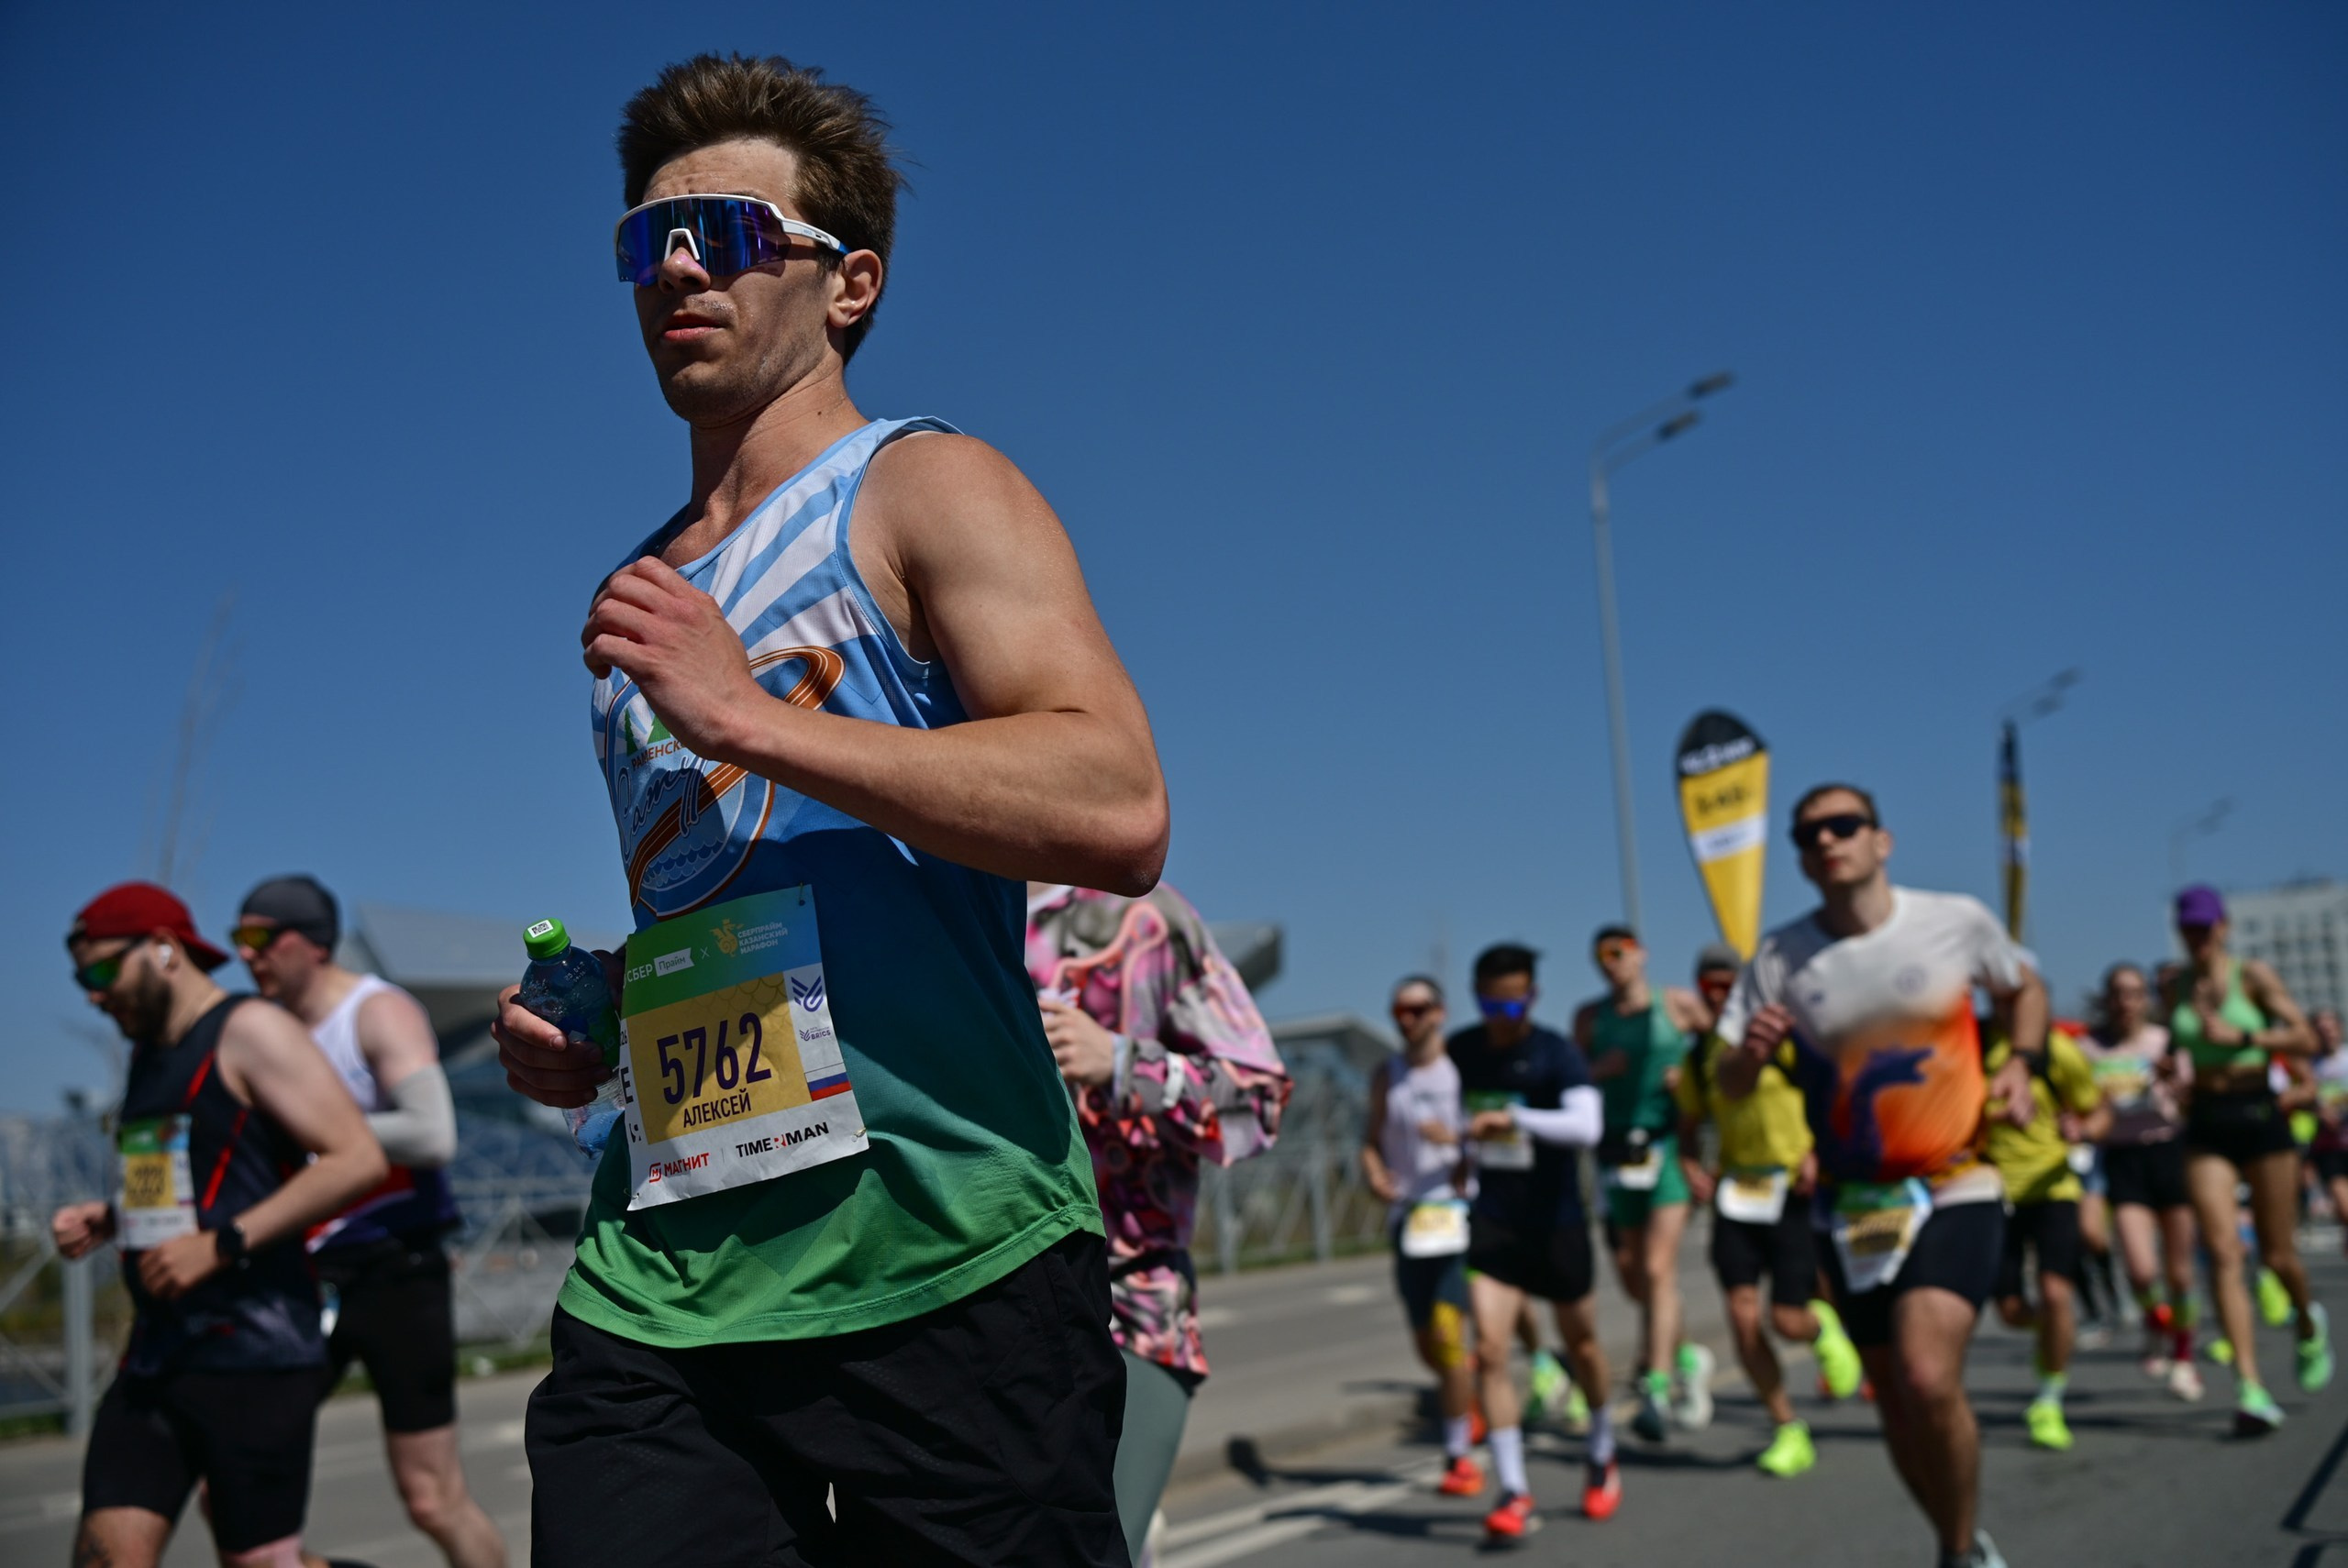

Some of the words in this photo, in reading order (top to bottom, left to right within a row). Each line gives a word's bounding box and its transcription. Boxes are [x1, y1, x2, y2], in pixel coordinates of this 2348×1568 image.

[631, 740, 681, 769] РАМЕНСК
[737, 922, 783, 938] СБЕРПРАЙМ
[738, 928, 789, 946] КАЗАНСКИЙ
[740, 938, 779, 955] МАРАФОН
[626, 964, 654, 983] СБЕР
[659, 955, 687, 971] Прайм
[811, 1030, 831, 1040] BRICS
[656, 1011, 772, 1105] 5762
[682, 1088, 752, 1129] АЛЕКСЕЙ
[664, 1153, 710, 1176] МАГНИТ
